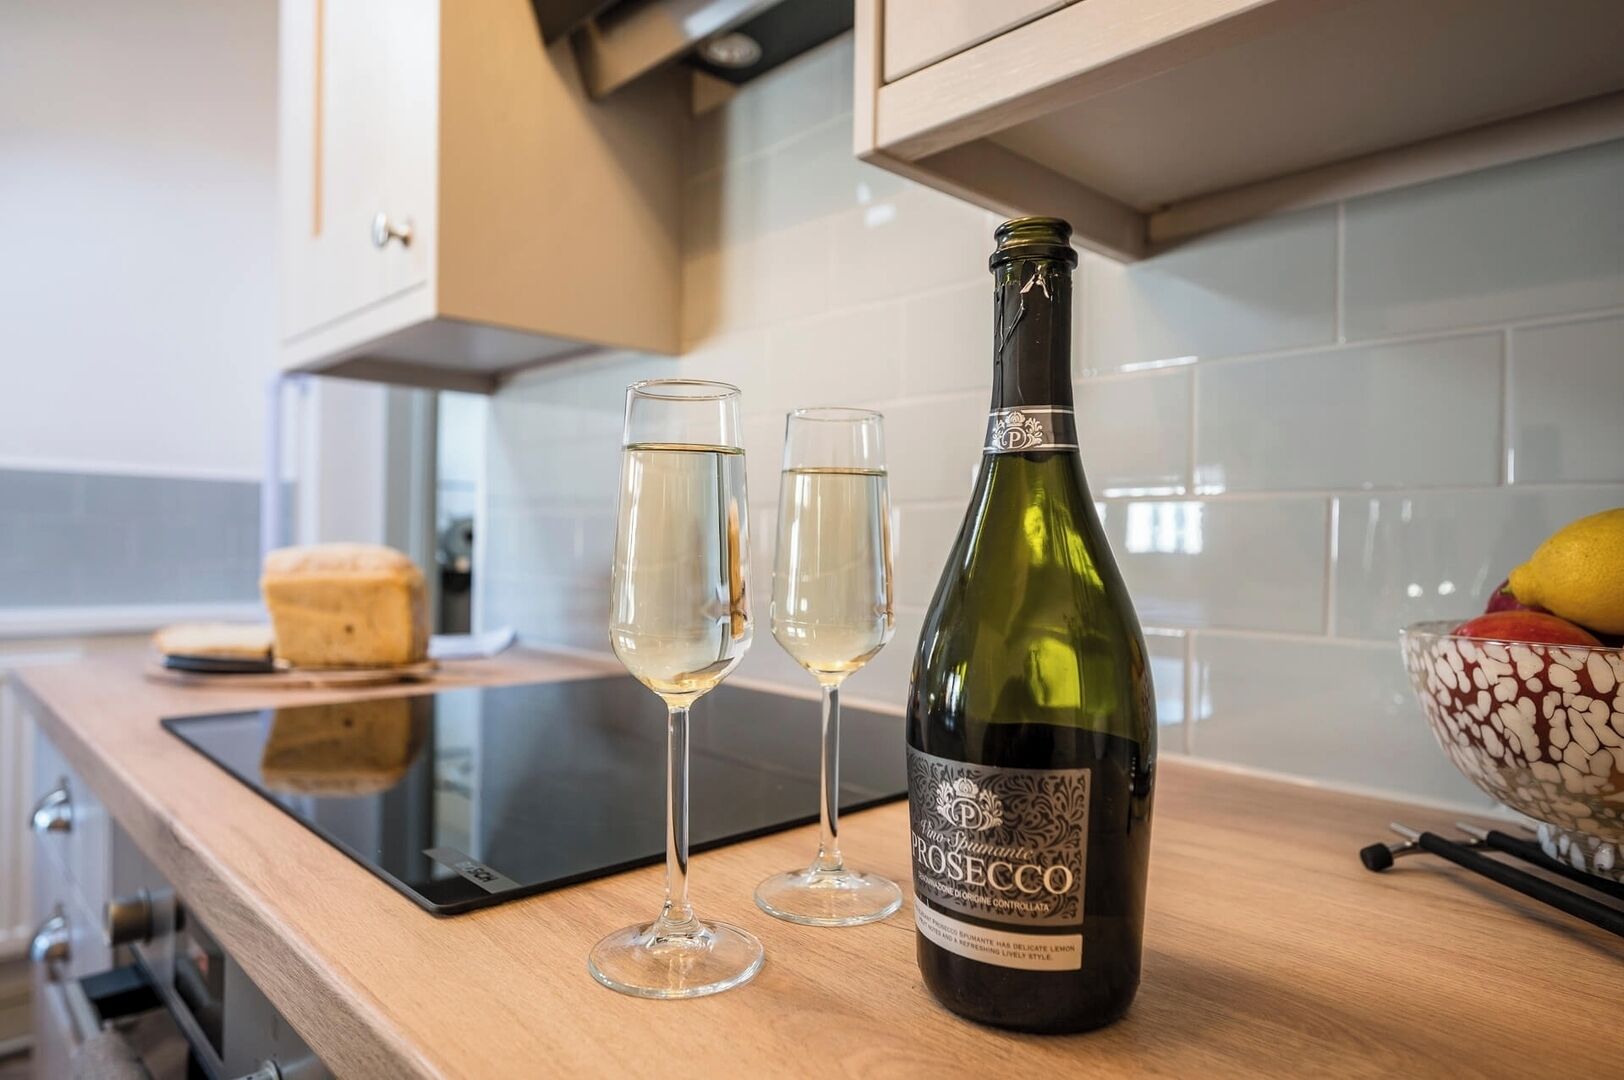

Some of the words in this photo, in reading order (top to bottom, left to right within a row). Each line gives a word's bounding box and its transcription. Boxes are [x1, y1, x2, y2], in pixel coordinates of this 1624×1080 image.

[920, 819, 945, 843] Vino
[947, 830, 1035, 860] Spumante
[911, 830, 1074, 895] PROSECCO
[954, 889, 963, 899] DI
[962, 891, 992, 906] ORIGINE
[992, 899, 1050, 912] CONTROLLATA
[932, 917, 958, 935] PROSECCO
[958, 931, 994, 947] SPUMANTE
[996, 940, 1011, 949] HAS
[1012, 943, 1049, 952] DELICATE
[1050, 944, 1075, 953] LEMON
[942, 932, 953, 942] AND
[958, 940, 1000, 956] REFRESHING
[1001, 950, 1026, 960] LIVELY
